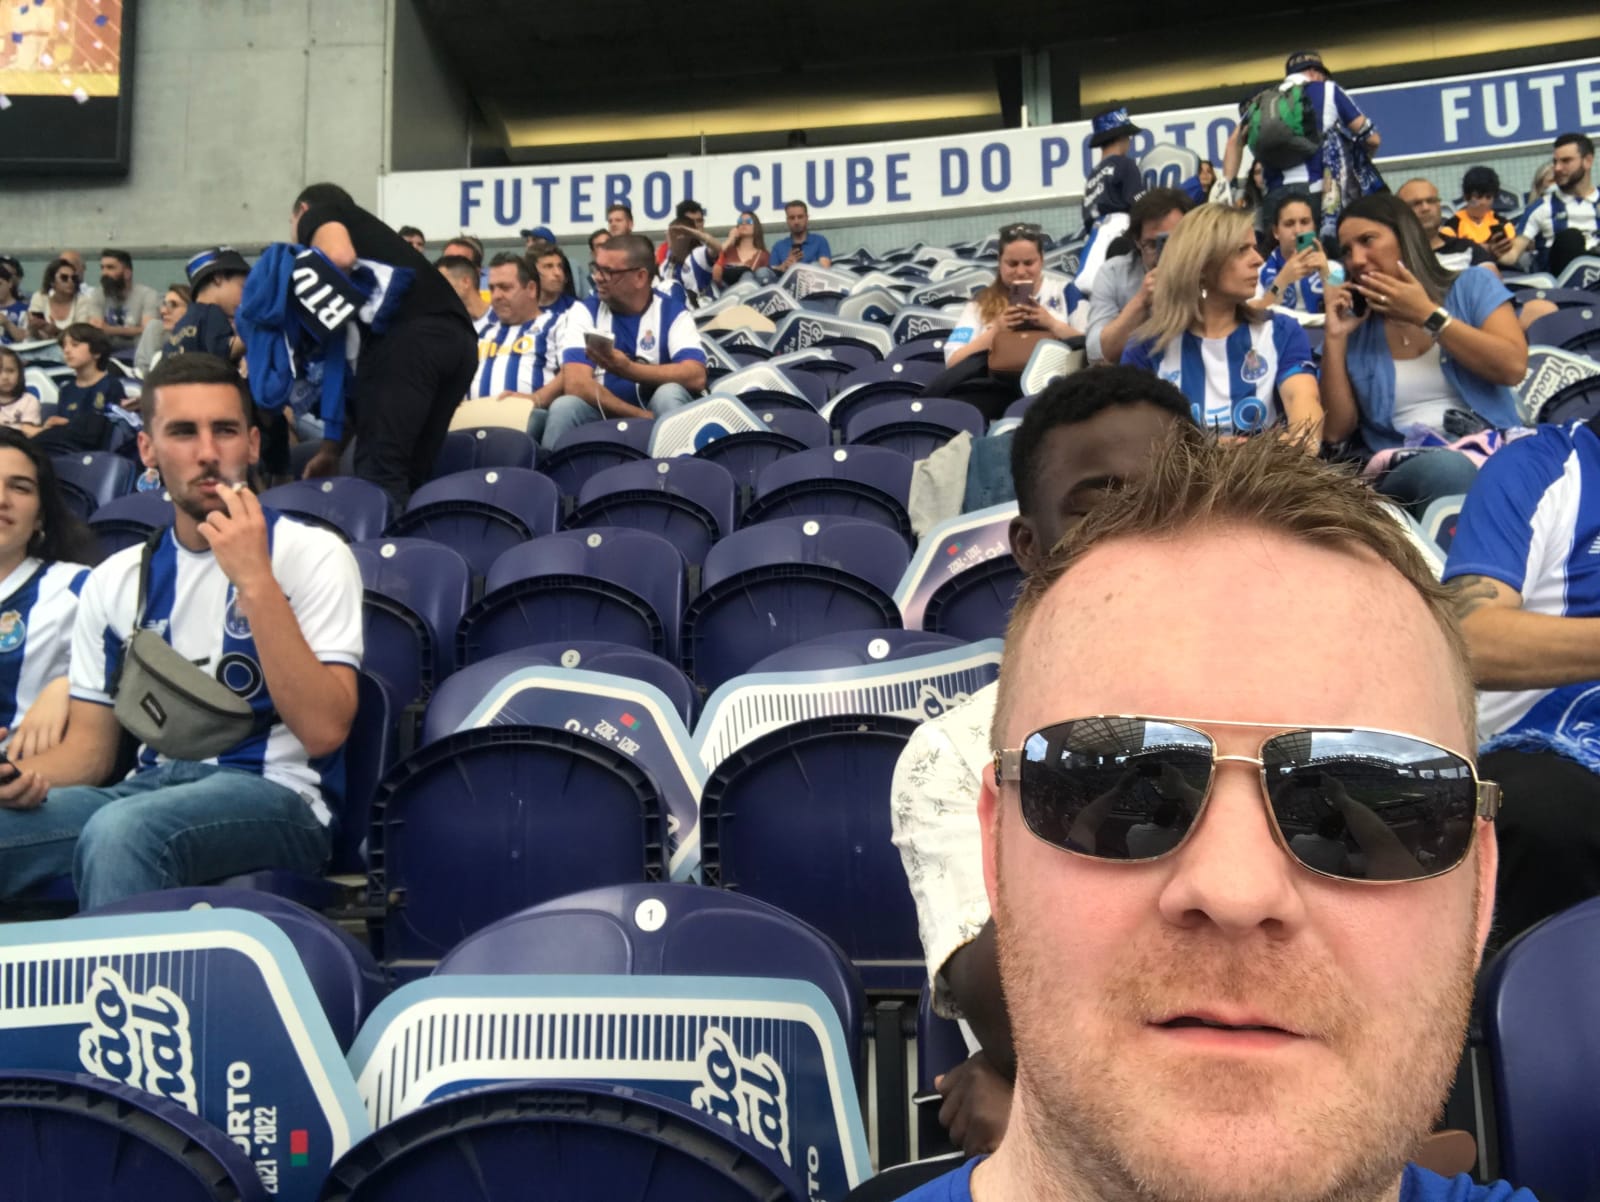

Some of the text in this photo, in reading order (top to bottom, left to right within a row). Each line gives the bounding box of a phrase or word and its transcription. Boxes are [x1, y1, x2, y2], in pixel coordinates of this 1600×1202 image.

[732, 152, 912, 214] CLUBE
[939, 141, 1012, 198] DO
[226, 1060, 252, 1157] RTO
[253, 1105, 278, 1145] 2022
